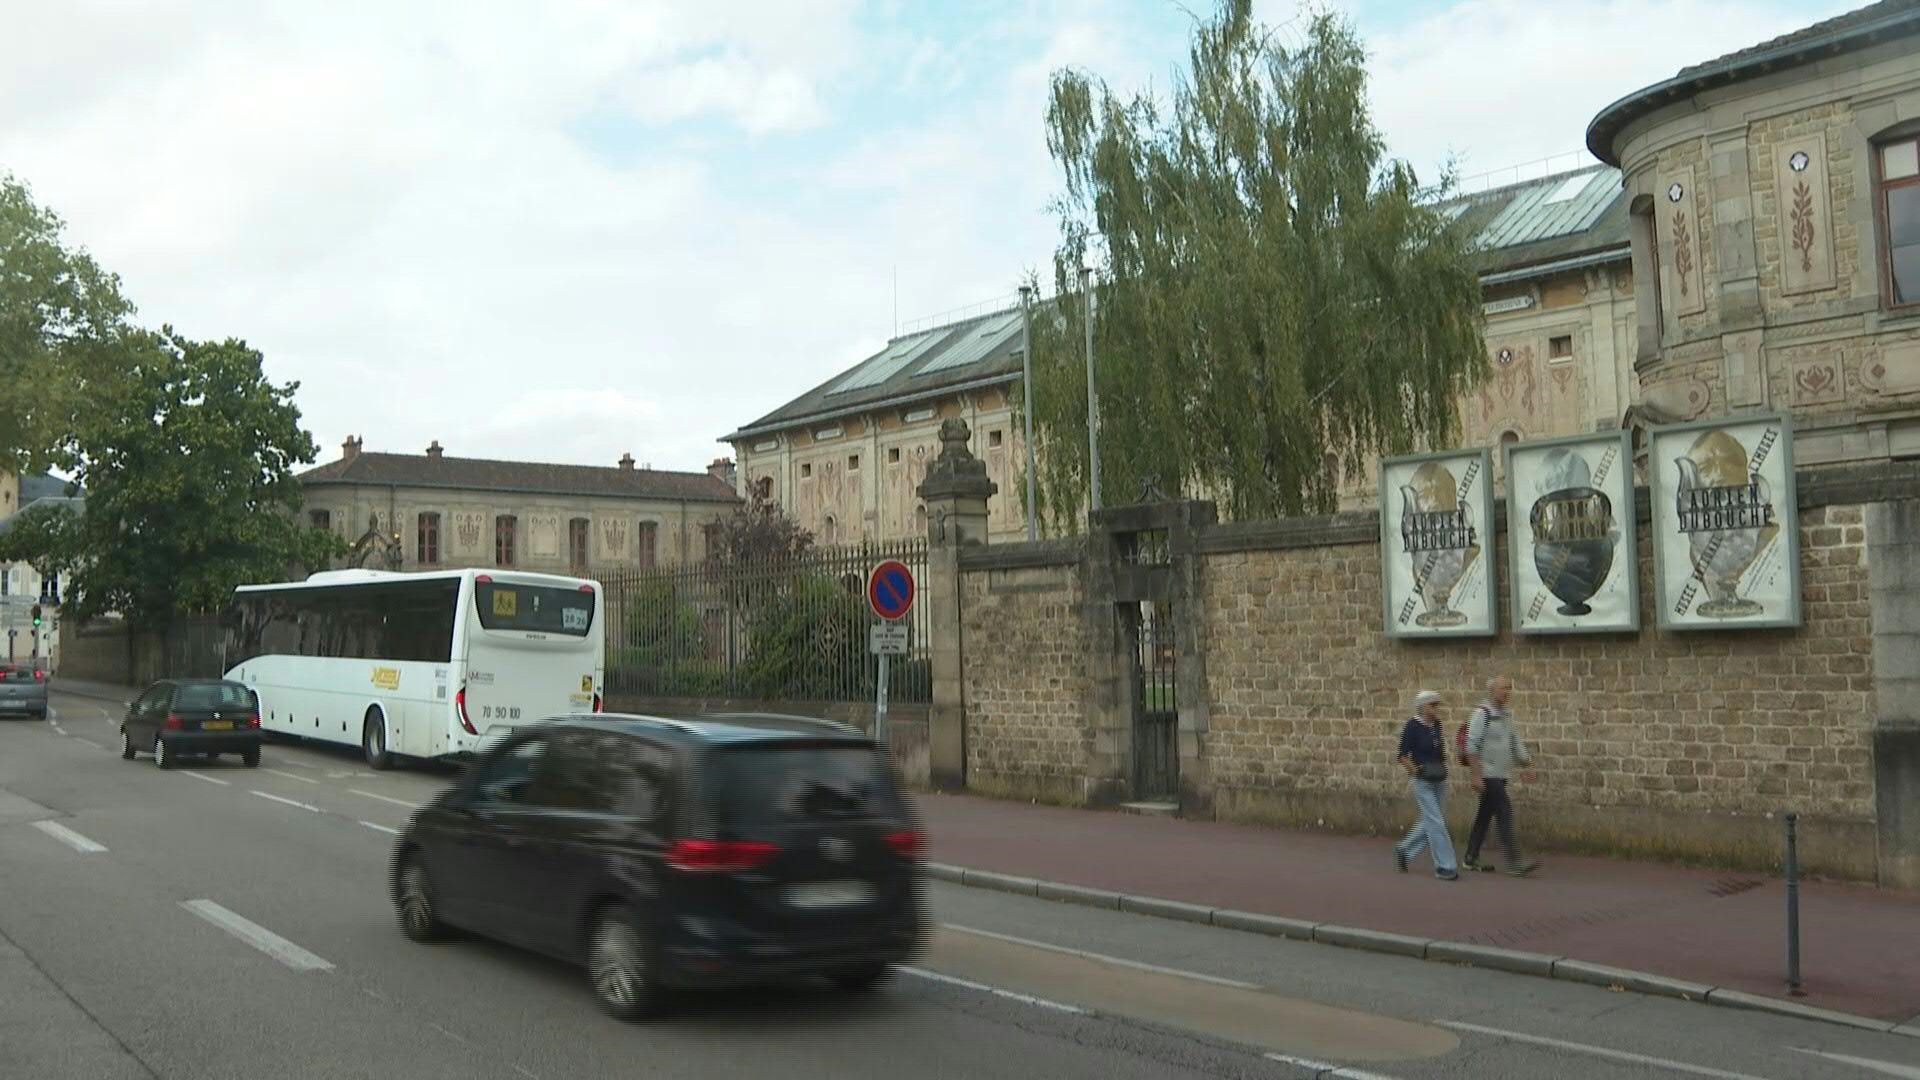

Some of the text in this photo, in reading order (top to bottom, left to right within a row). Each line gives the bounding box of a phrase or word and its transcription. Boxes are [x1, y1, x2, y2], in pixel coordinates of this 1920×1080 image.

[1748, 427, 1778, 472] LIMOGES
[1691, 484, 1758, 512] ADRIEN
[482, 706, 491, 719] 70
[509, 706, 521, 719] 100
